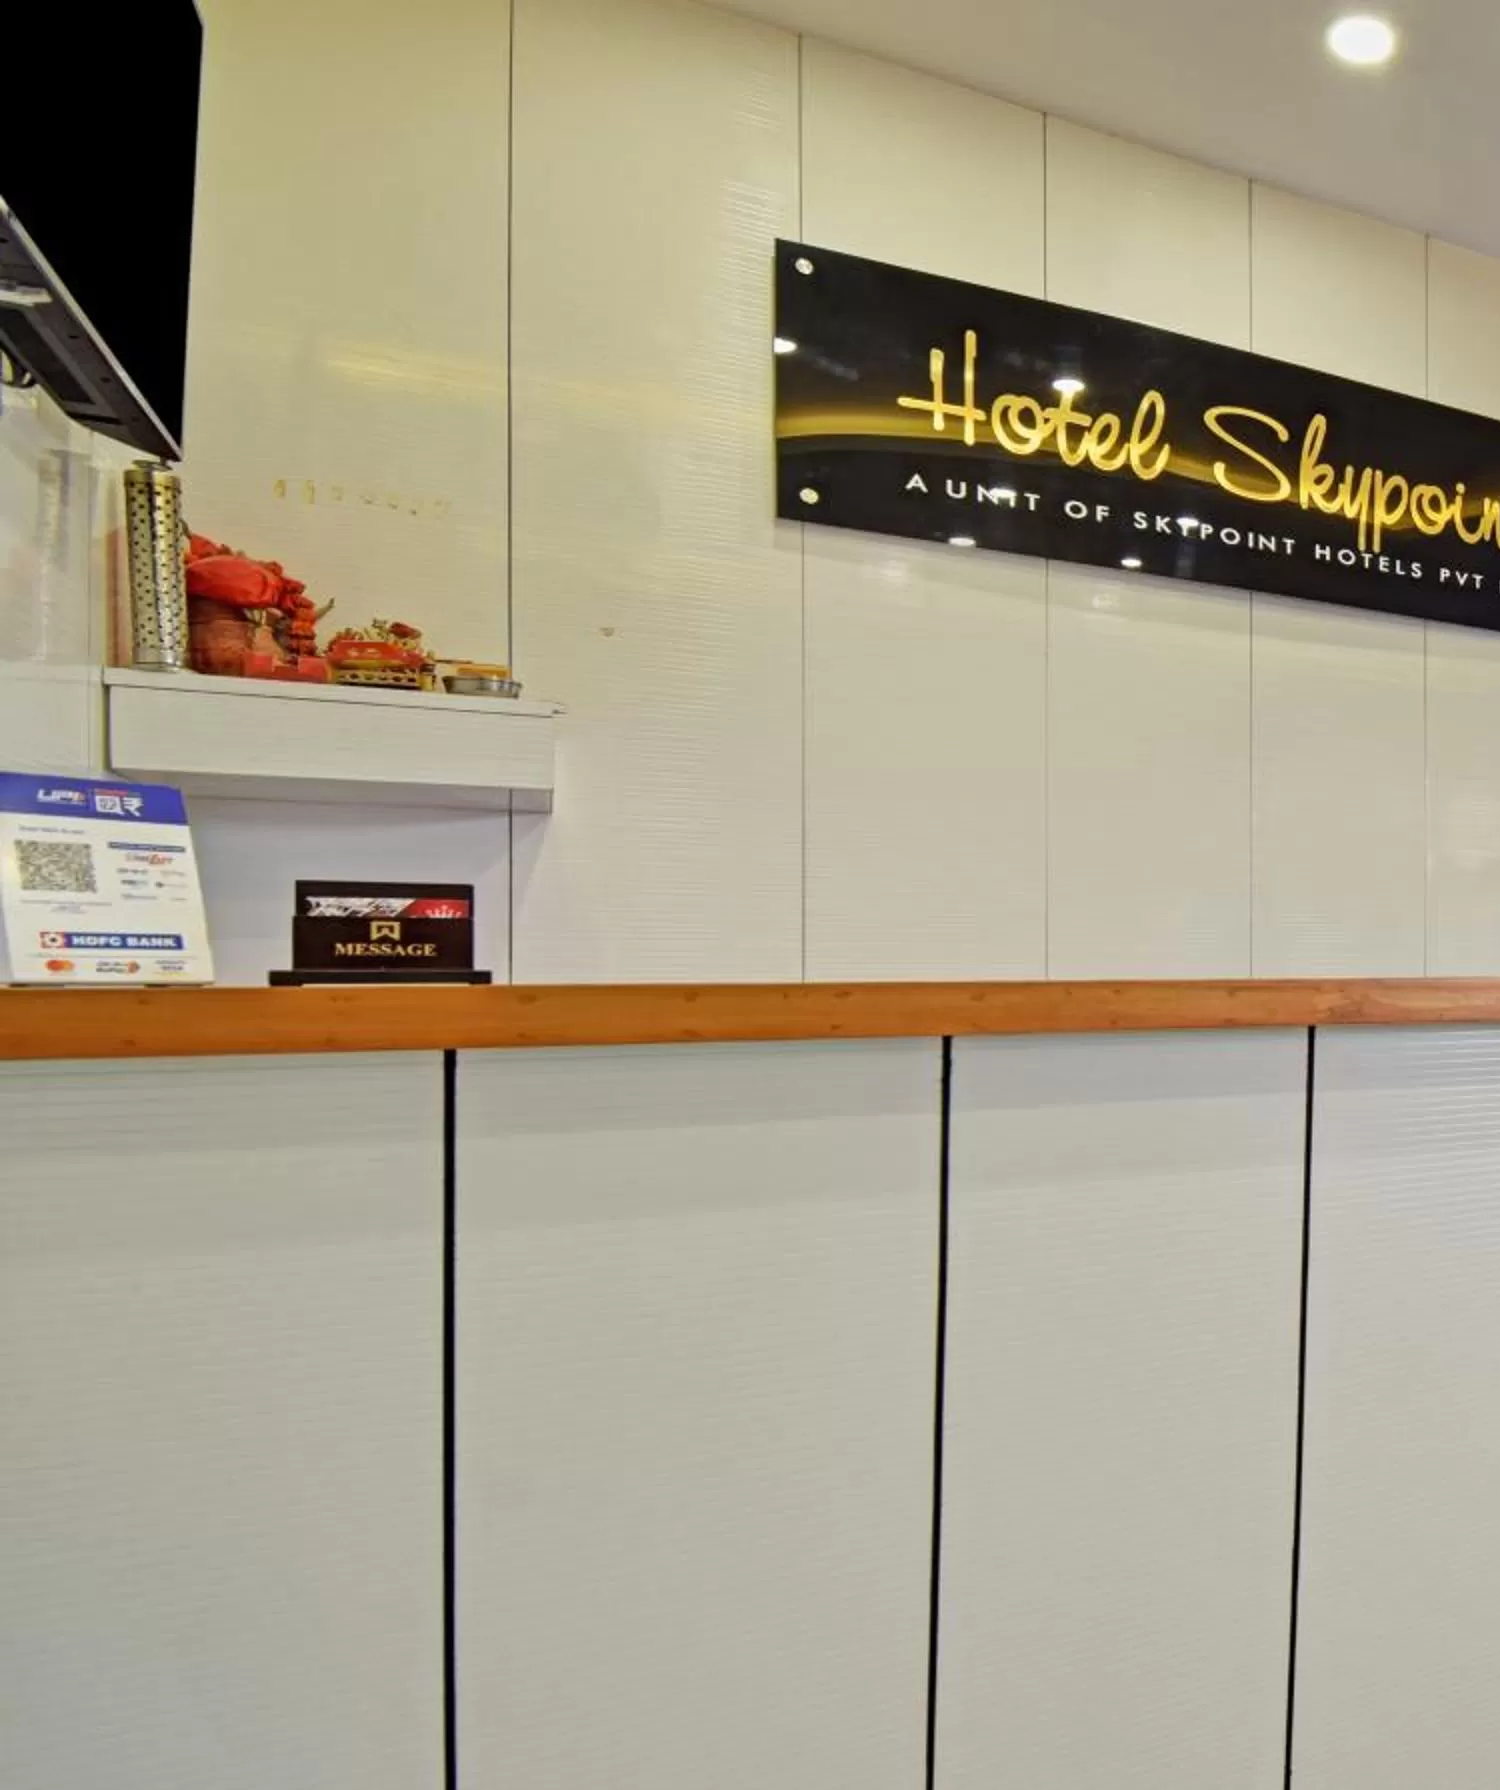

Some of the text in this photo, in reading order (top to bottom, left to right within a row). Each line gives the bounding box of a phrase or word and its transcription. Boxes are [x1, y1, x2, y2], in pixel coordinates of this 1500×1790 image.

[897, 329, 1171, 480] Hotel
[905, 473, 928, 493] A
[945, 479, 1041, 511] UNIT
[1064, 500, 1110, 523] OF
[1133, 512, 1297, 555] SKYPOINT
[1315, 543, 1424, 580] HOTELS
[1439, 567, 1486, 591] PVT
[71, 934, 178, 948] HDFC BANK
[334, 942, 437, 957] MESSAGE
